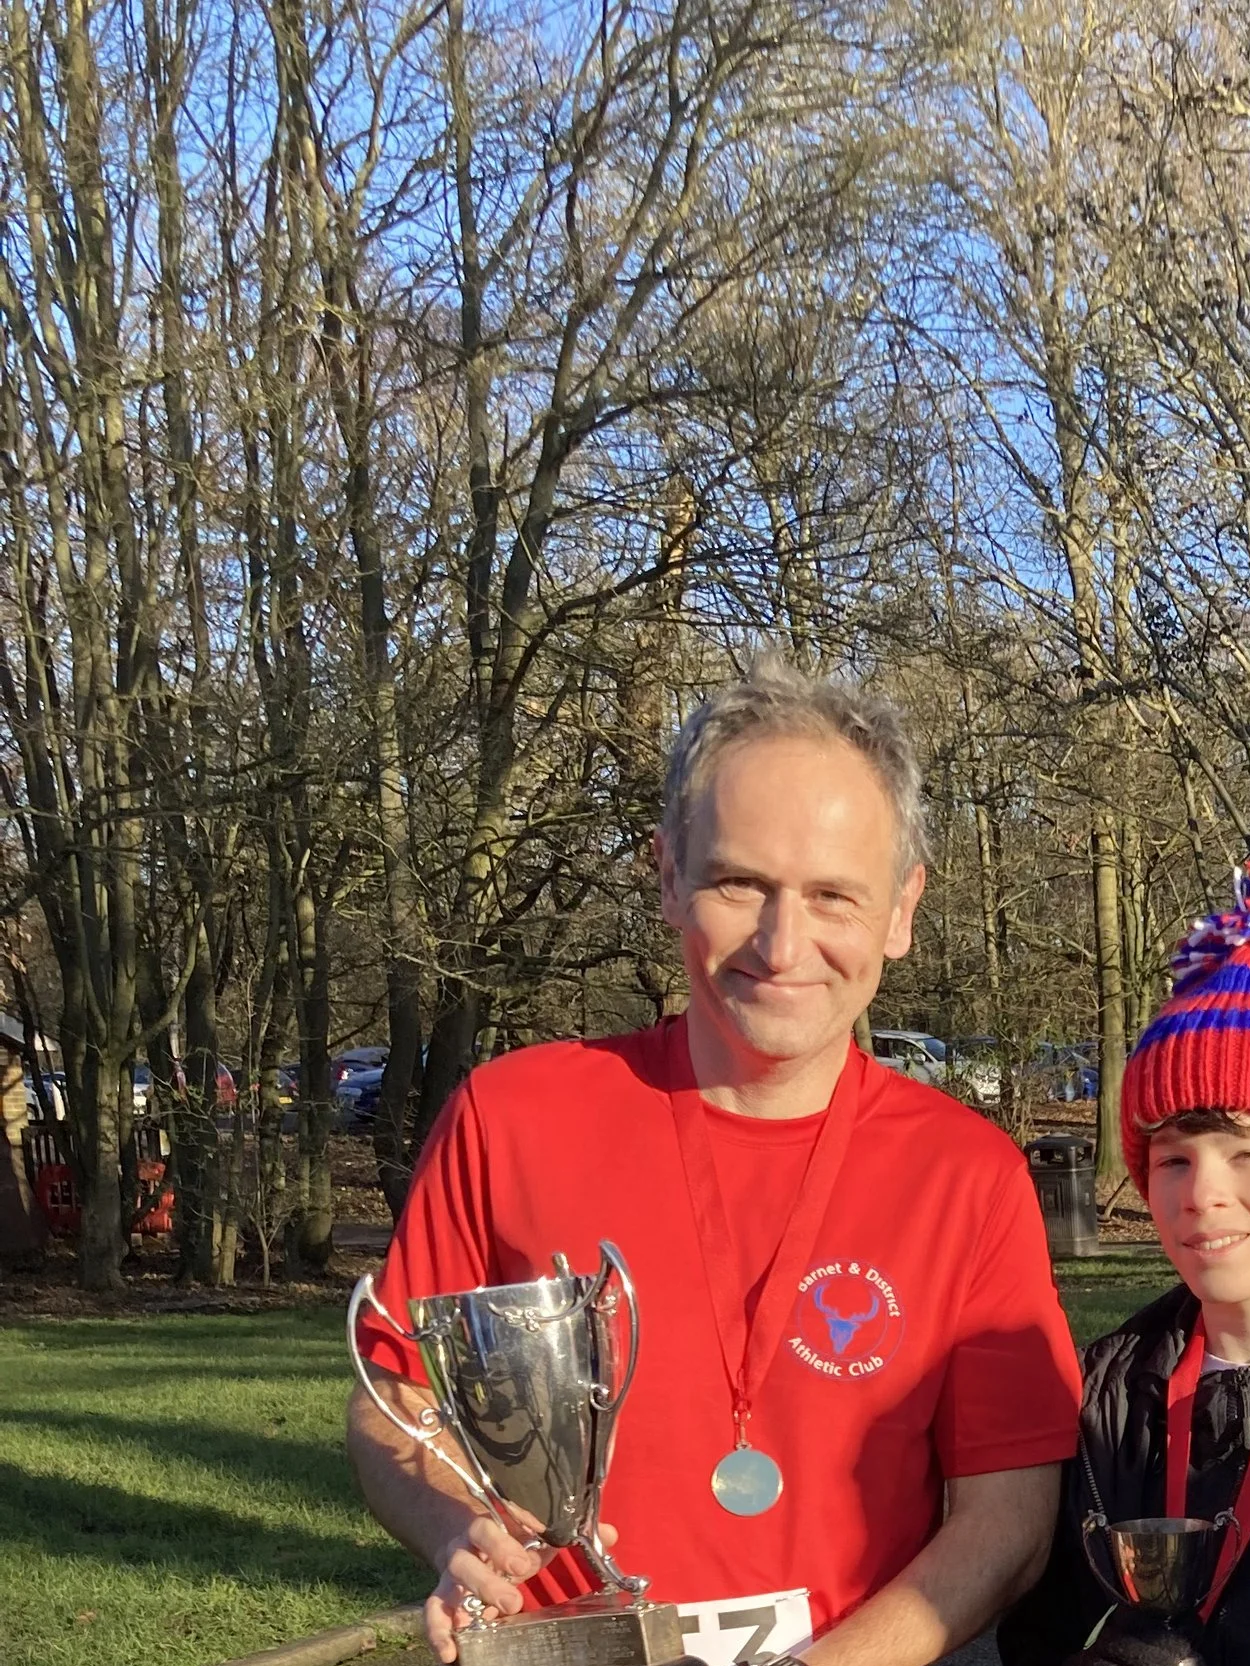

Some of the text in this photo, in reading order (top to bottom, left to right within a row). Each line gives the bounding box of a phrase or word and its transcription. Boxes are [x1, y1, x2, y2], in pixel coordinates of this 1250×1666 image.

[848, 1262, 861, 1275] &
[865, 1268, 901, 1318] District
[788, 1336, 884, 1377] Athletic Club
